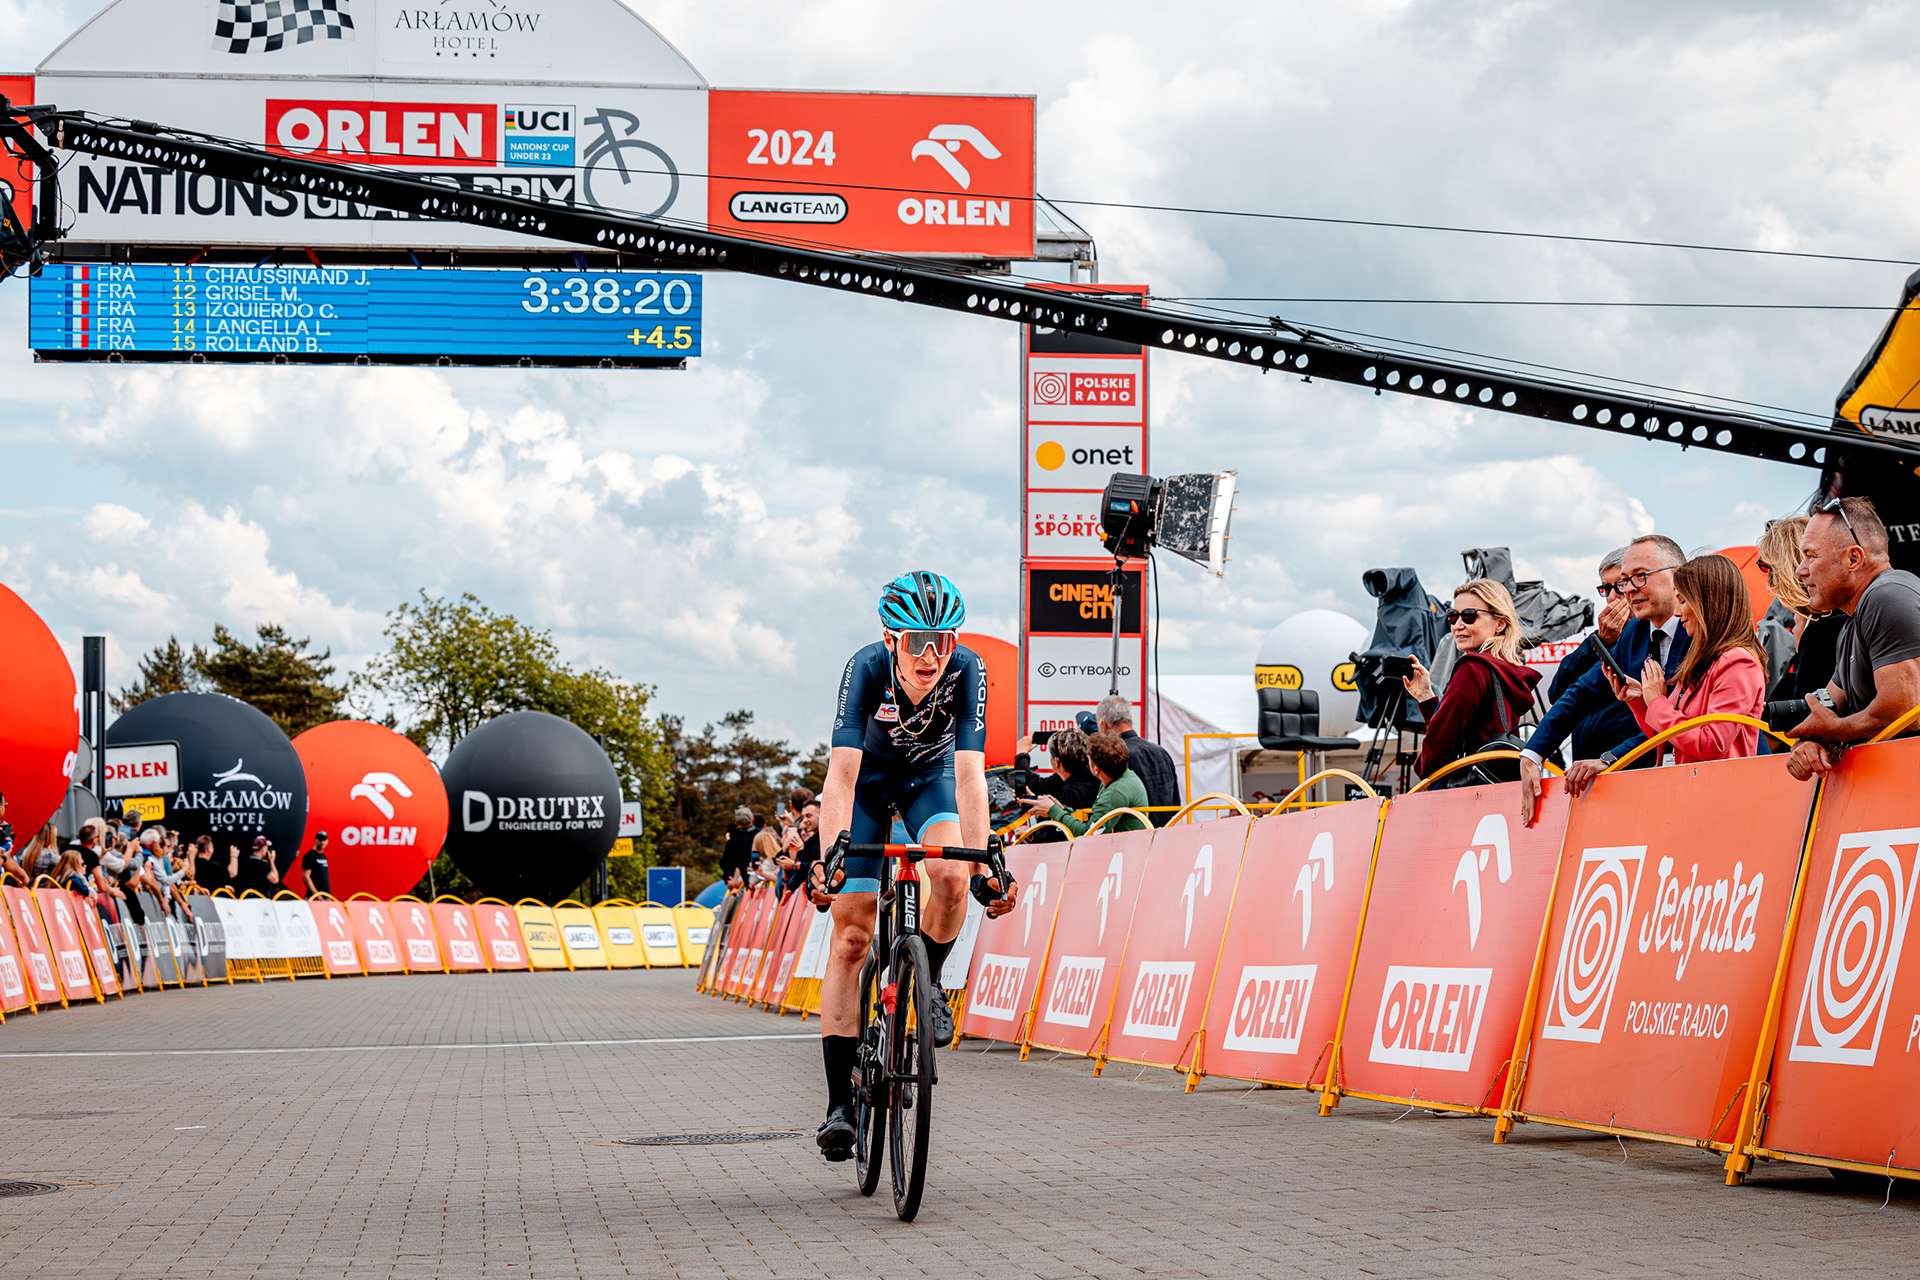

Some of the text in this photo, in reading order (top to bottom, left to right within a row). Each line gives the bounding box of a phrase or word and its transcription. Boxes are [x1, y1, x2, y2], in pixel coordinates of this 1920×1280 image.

[394, 5, 541, 32] ARŁAMÓW
[433, 36, 498, 51] HOTEL
[276, 107, 483, 158] ORLEN
[517, 110, 569, 132] UCI
[510, 152, 552, 161] UNDER 23
[552, 143, 570, 152] CUP
[747, 129, 836, 166] 2024
[78, 165, 298, 217] NATIONS
[739, 200, 839, 216] LANGTEAM
[897, 198, 1010, 227] ORLEN
[97, 267, 370, 286] FRA 11 CHAUSSINAND J.
[97, 284, 302, 302] FRA 12 GRISEL M.
[521, 276, 693, 315] 3:38:20
[97, 301, 338, 319] FRA 13 IZQUIERDO C.
[97, 318, 331, 336] FRA 14 LANGELLA L.
[626, 325, 693, 350] +4.5
[97, 335, 322, 353] FRA 15 ROLLAND B.
[1075, 377, 1131, 389] POLSKIE
[1075, 390, 1131, 402] RADIO
[1072, 445, 1133, 465] onet
[1035, 522, 1102, 537] SPORT
[843, 658, 856, 688] weber
[105, 762, 168, 780] ORLEN
[172, 784, 293, 811] ARŁAMÓW
[497, 796, 606, 820] DRUTEX
[209, 812, 266, 826] HOTEL
[499, 820, 604, 831] ENGINEERED FOR YOU
[341, 826, 417, 846] ORLEN
[904, 884, 916, 929] BMC
[1637, 854, 1764, 982] Jedynka
[976, 962, 1026, 1011] ORLEN
[1051, 965, 1100, 1016] ORLEN
[1130, 972, 1187, 1027] ORLEN
[1234, 977, 1309, 1040] ORLEN
[1380, 979, 1482, 1054] ORLEN
[1623, 1000, 1729, 1040] POLSKIE RADIO
